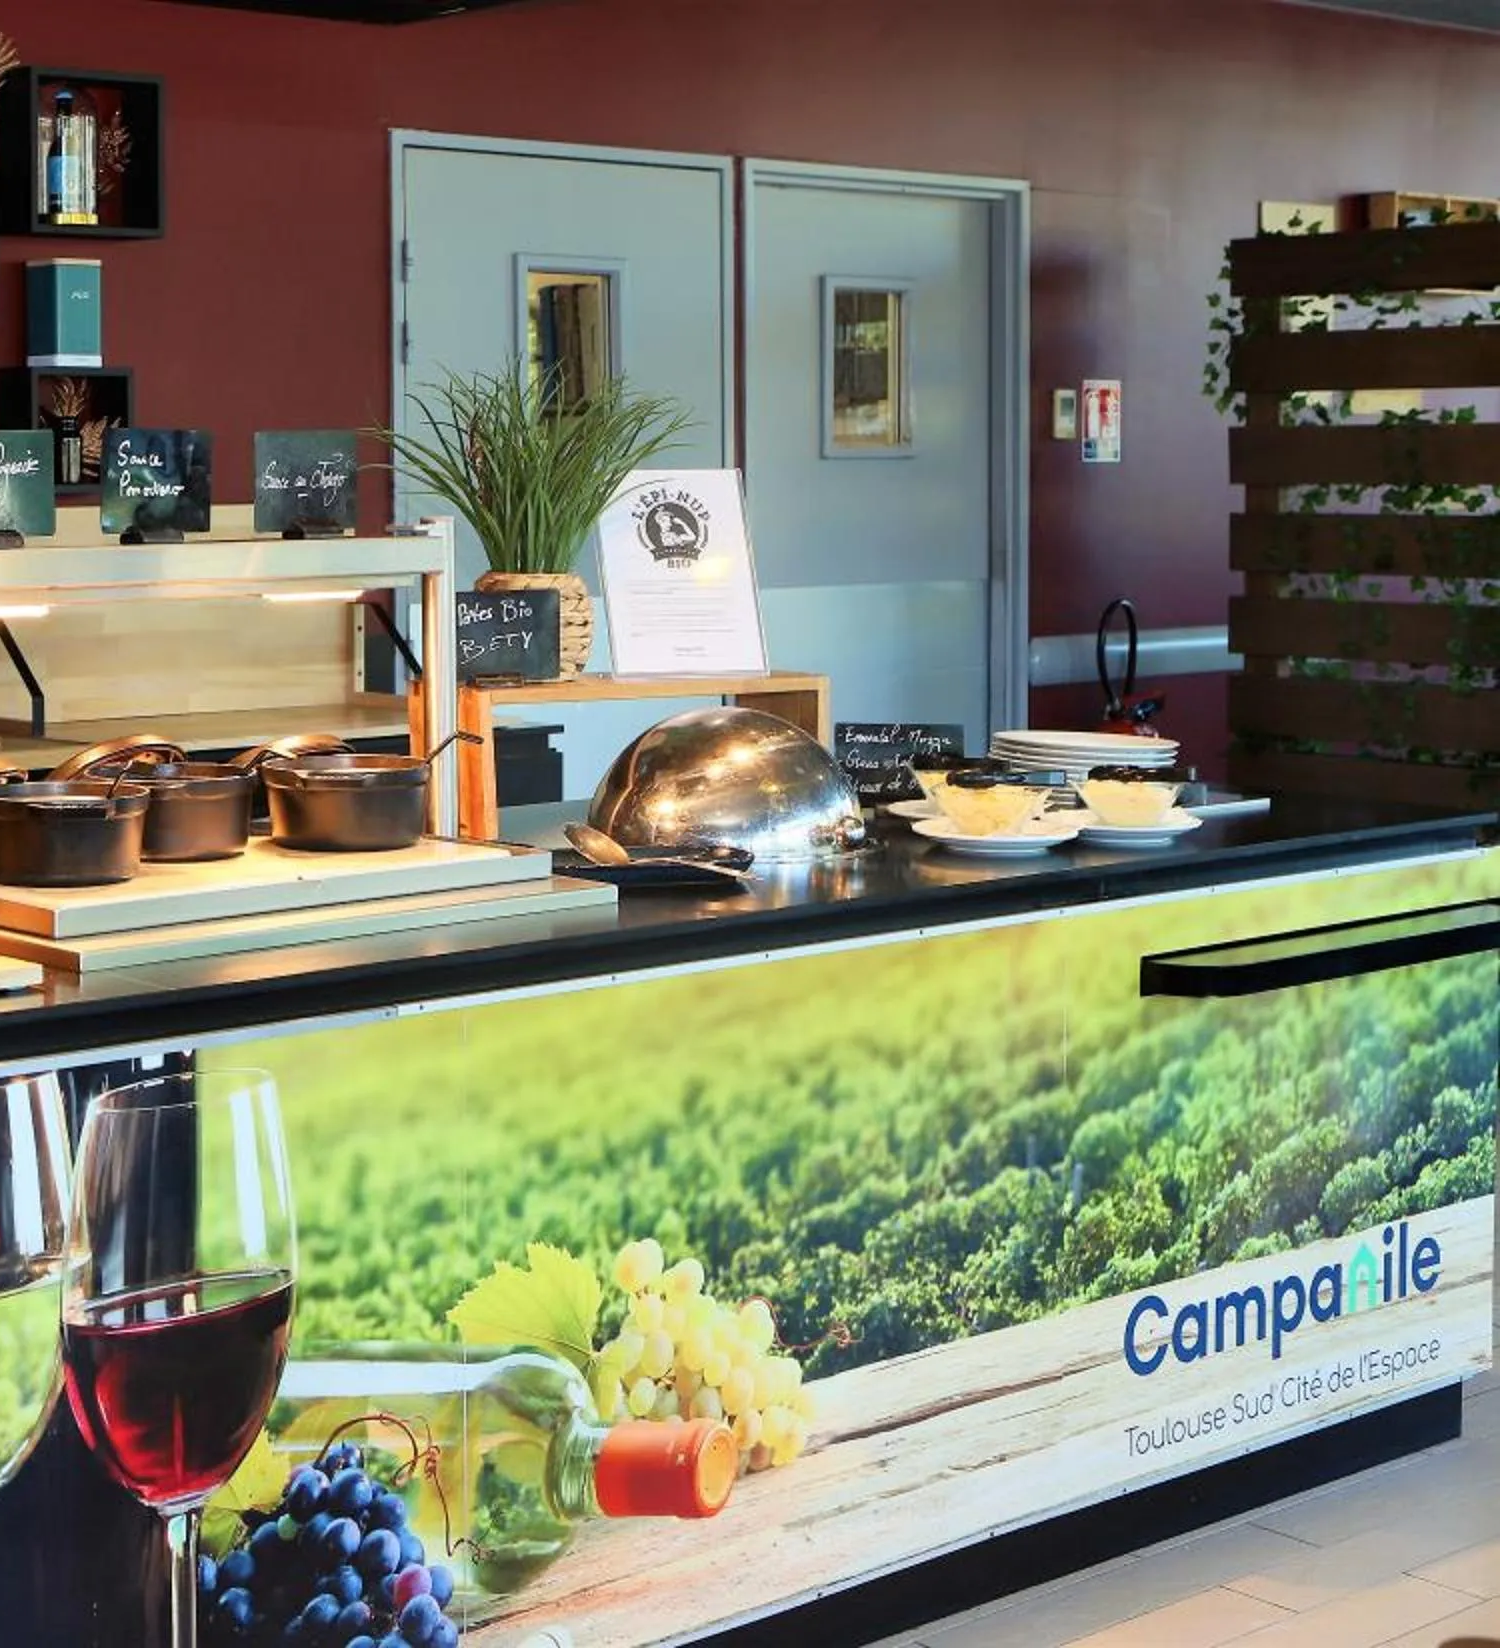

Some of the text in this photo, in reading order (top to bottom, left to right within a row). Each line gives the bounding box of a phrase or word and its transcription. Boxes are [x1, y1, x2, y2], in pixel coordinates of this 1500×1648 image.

[117, 440, 164, 468] Sauce
[500, 599, 533, 622] Bio
[460, 630, 533, 667] BETY
[1123, 1221, 1442, 1377] Campanile
[1124, 1405, 1228, 1458] Toulouse
[1280, 1371, 1324, 1408] Cité
[1327, 1361, 1356, 1393] de
[1358, 1336, 1442, 1386] l'Espace
